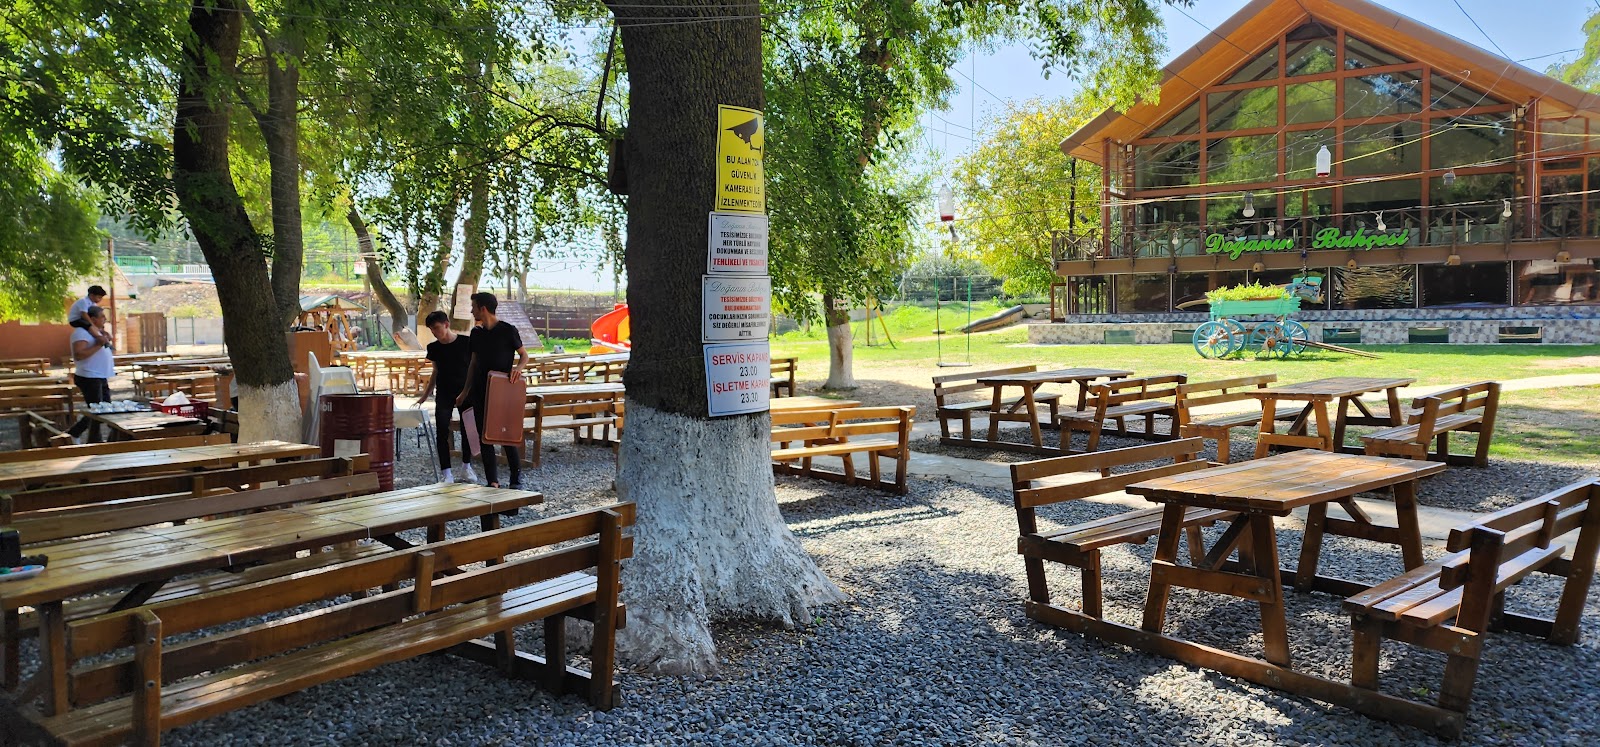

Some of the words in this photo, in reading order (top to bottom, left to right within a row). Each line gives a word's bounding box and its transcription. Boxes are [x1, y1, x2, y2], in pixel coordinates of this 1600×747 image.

[726, 155, 735, 164] BU
[731, 169, 757, 180] GÜVENLİK
[724, 184, 753, 194] KAMERASI
[720, 231, 748, 239] TESİSİMİZDE
[733, 239, 746, 247] TÜRLÜ
[1205, 233, 1295, 260] Doğanın
[1312, 227, 1410, 251] Bahçesi
[713, 257, 741, 266] TEHLİKELİ
[742, 258, 748, 266] VE
[710, 280, 747, 295] Doğanın
[720, 295, 748, 303] TESİSİMİZDE
[708, 313, 747, 321] ÇOCUKLARINIZIN
[712, 321, 721, 329] SİZ
[722, 320, 740, 329] DEĞERLİ
[712, 351, 745, 366] SERVİS
[739, 366, 758, 377] 23.00
[713, 380, 749, 395] İŞLETME
[740, 392, 758, 404] 23.30
[320, 402, 333, 412] bil
